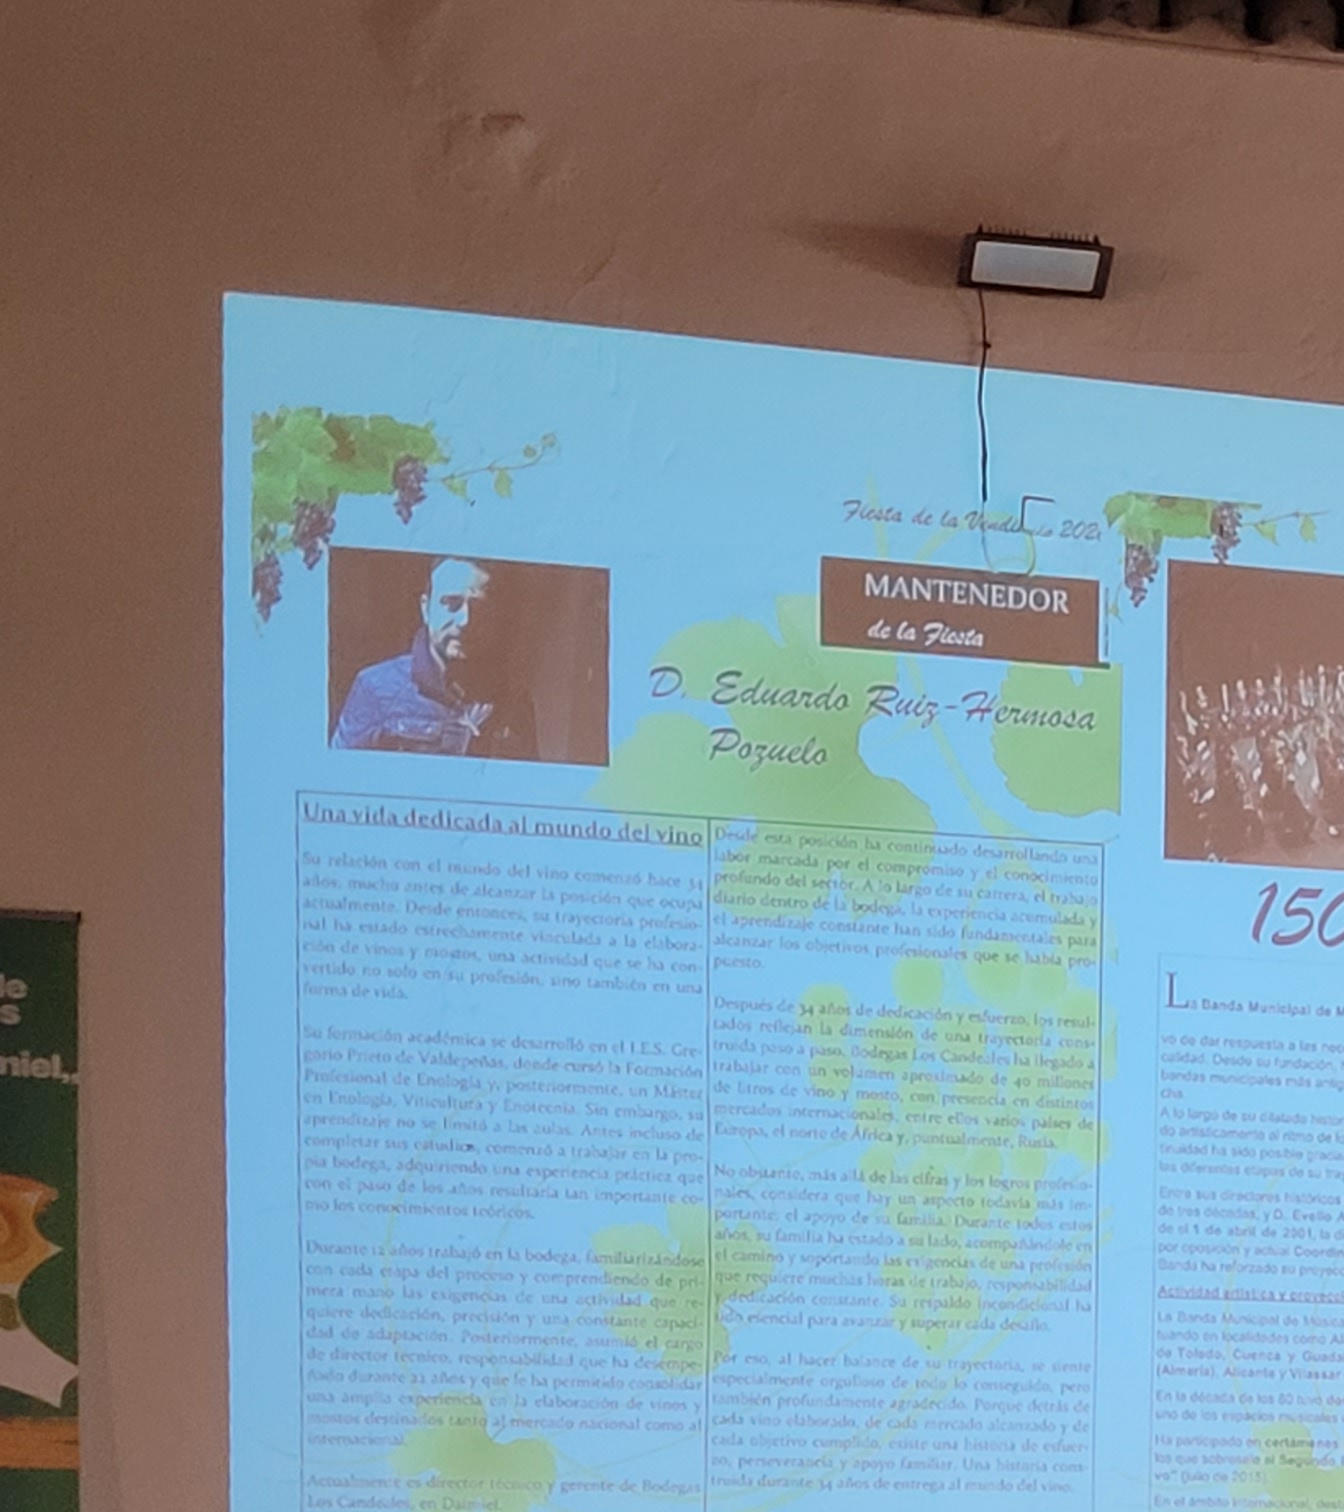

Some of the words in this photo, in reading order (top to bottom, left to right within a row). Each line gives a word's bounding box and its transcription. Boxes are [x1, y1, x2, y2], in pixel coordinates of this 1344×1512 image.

[843, 500, 902, 523] Fiesta
[912, 508, 933, 525] de
[940, 510, 959, 528] la
[864, 572, 1070, 615] MANTENEDOR
[867, 619, 892, 639] de
[897, 621, 917, 642] la
[923, 622, 985, 648] Fiesta
[650, 667, 686, 699] D.
[711, 671, 850, 712] Eduardo
[866, 685, 1097, 731] Ruiz-Hermosa
[709, 727, 828, 773] Pozuelo
[303, 800, 346, 822] Una
[351, 802, 397, 825] vida
[403, 805, 502, 832] dedicada
[508, 812, 526, 833] al
[534, 815, 611, 839] mundo
[617, 820, 649, 842] del
[655, 823, 703, 845] vino
